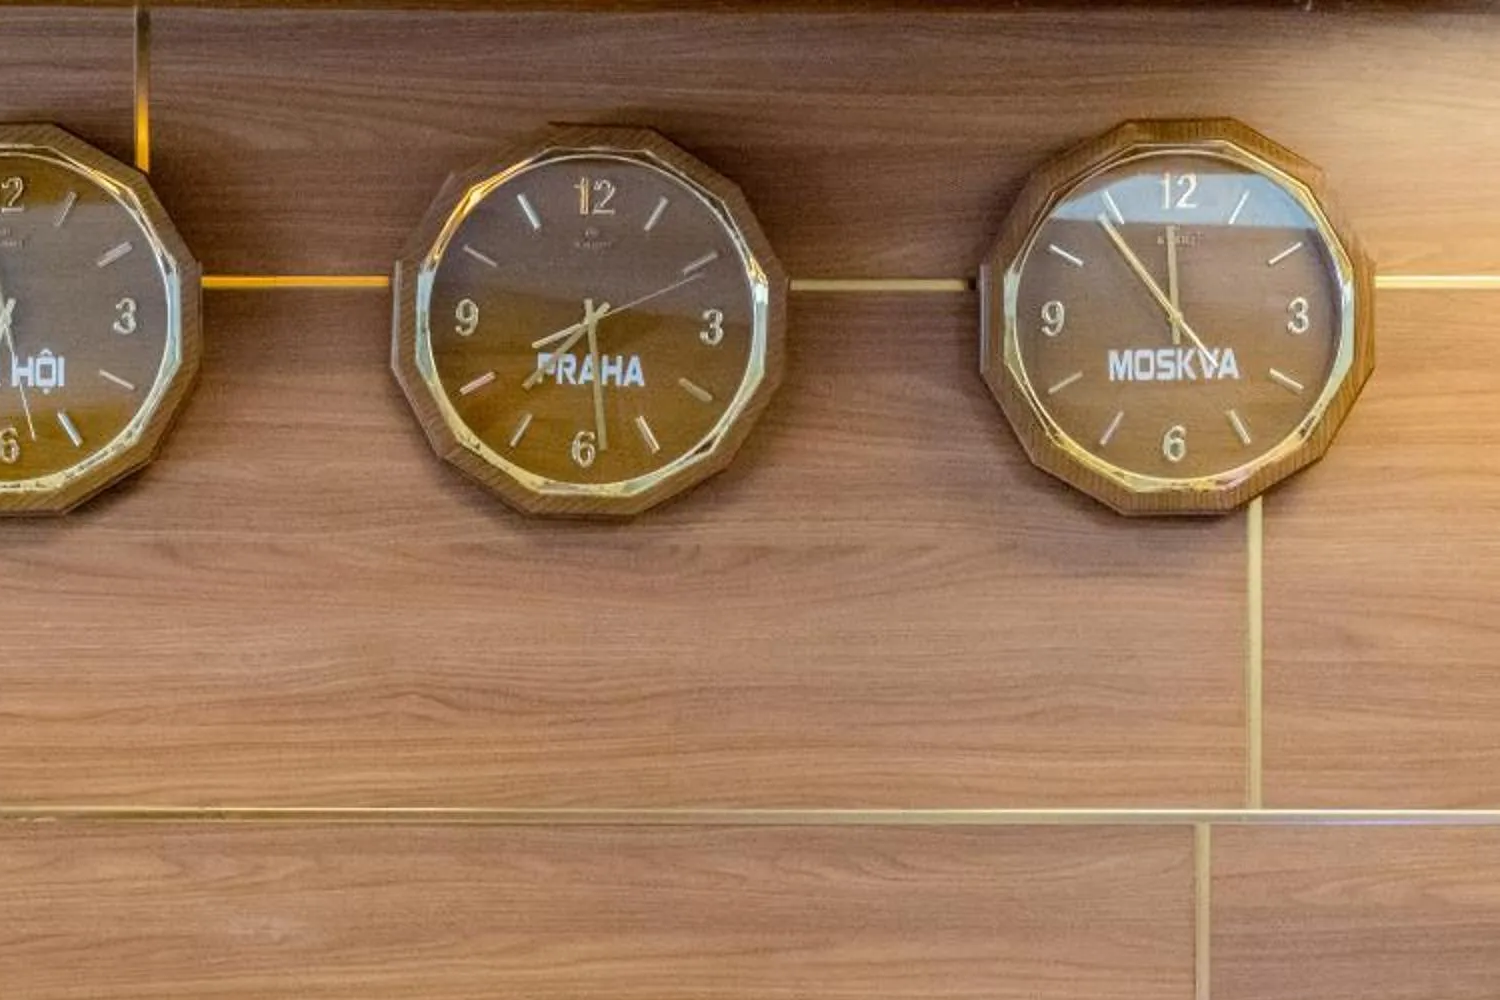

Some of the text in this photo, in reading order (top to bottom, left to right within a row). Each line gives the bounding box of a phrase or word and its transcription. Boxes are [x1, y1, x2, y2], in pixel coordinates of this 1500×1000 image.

[575, 177, 616, 216] 12
[1160, 173, 1198, 209] 12
[114, 298, 137, 334] 3
[456, 299, 479, 336] 9
[700, 309, 724, 345] 3
[1041, 300, 1065, 337] 9
[1288, 298, 1310, 334] 3
[1108, 347, 1240, 381] MOSKVA
[571, 431, 596, 467] 6
[1163, 425, 1187, 462] 6
